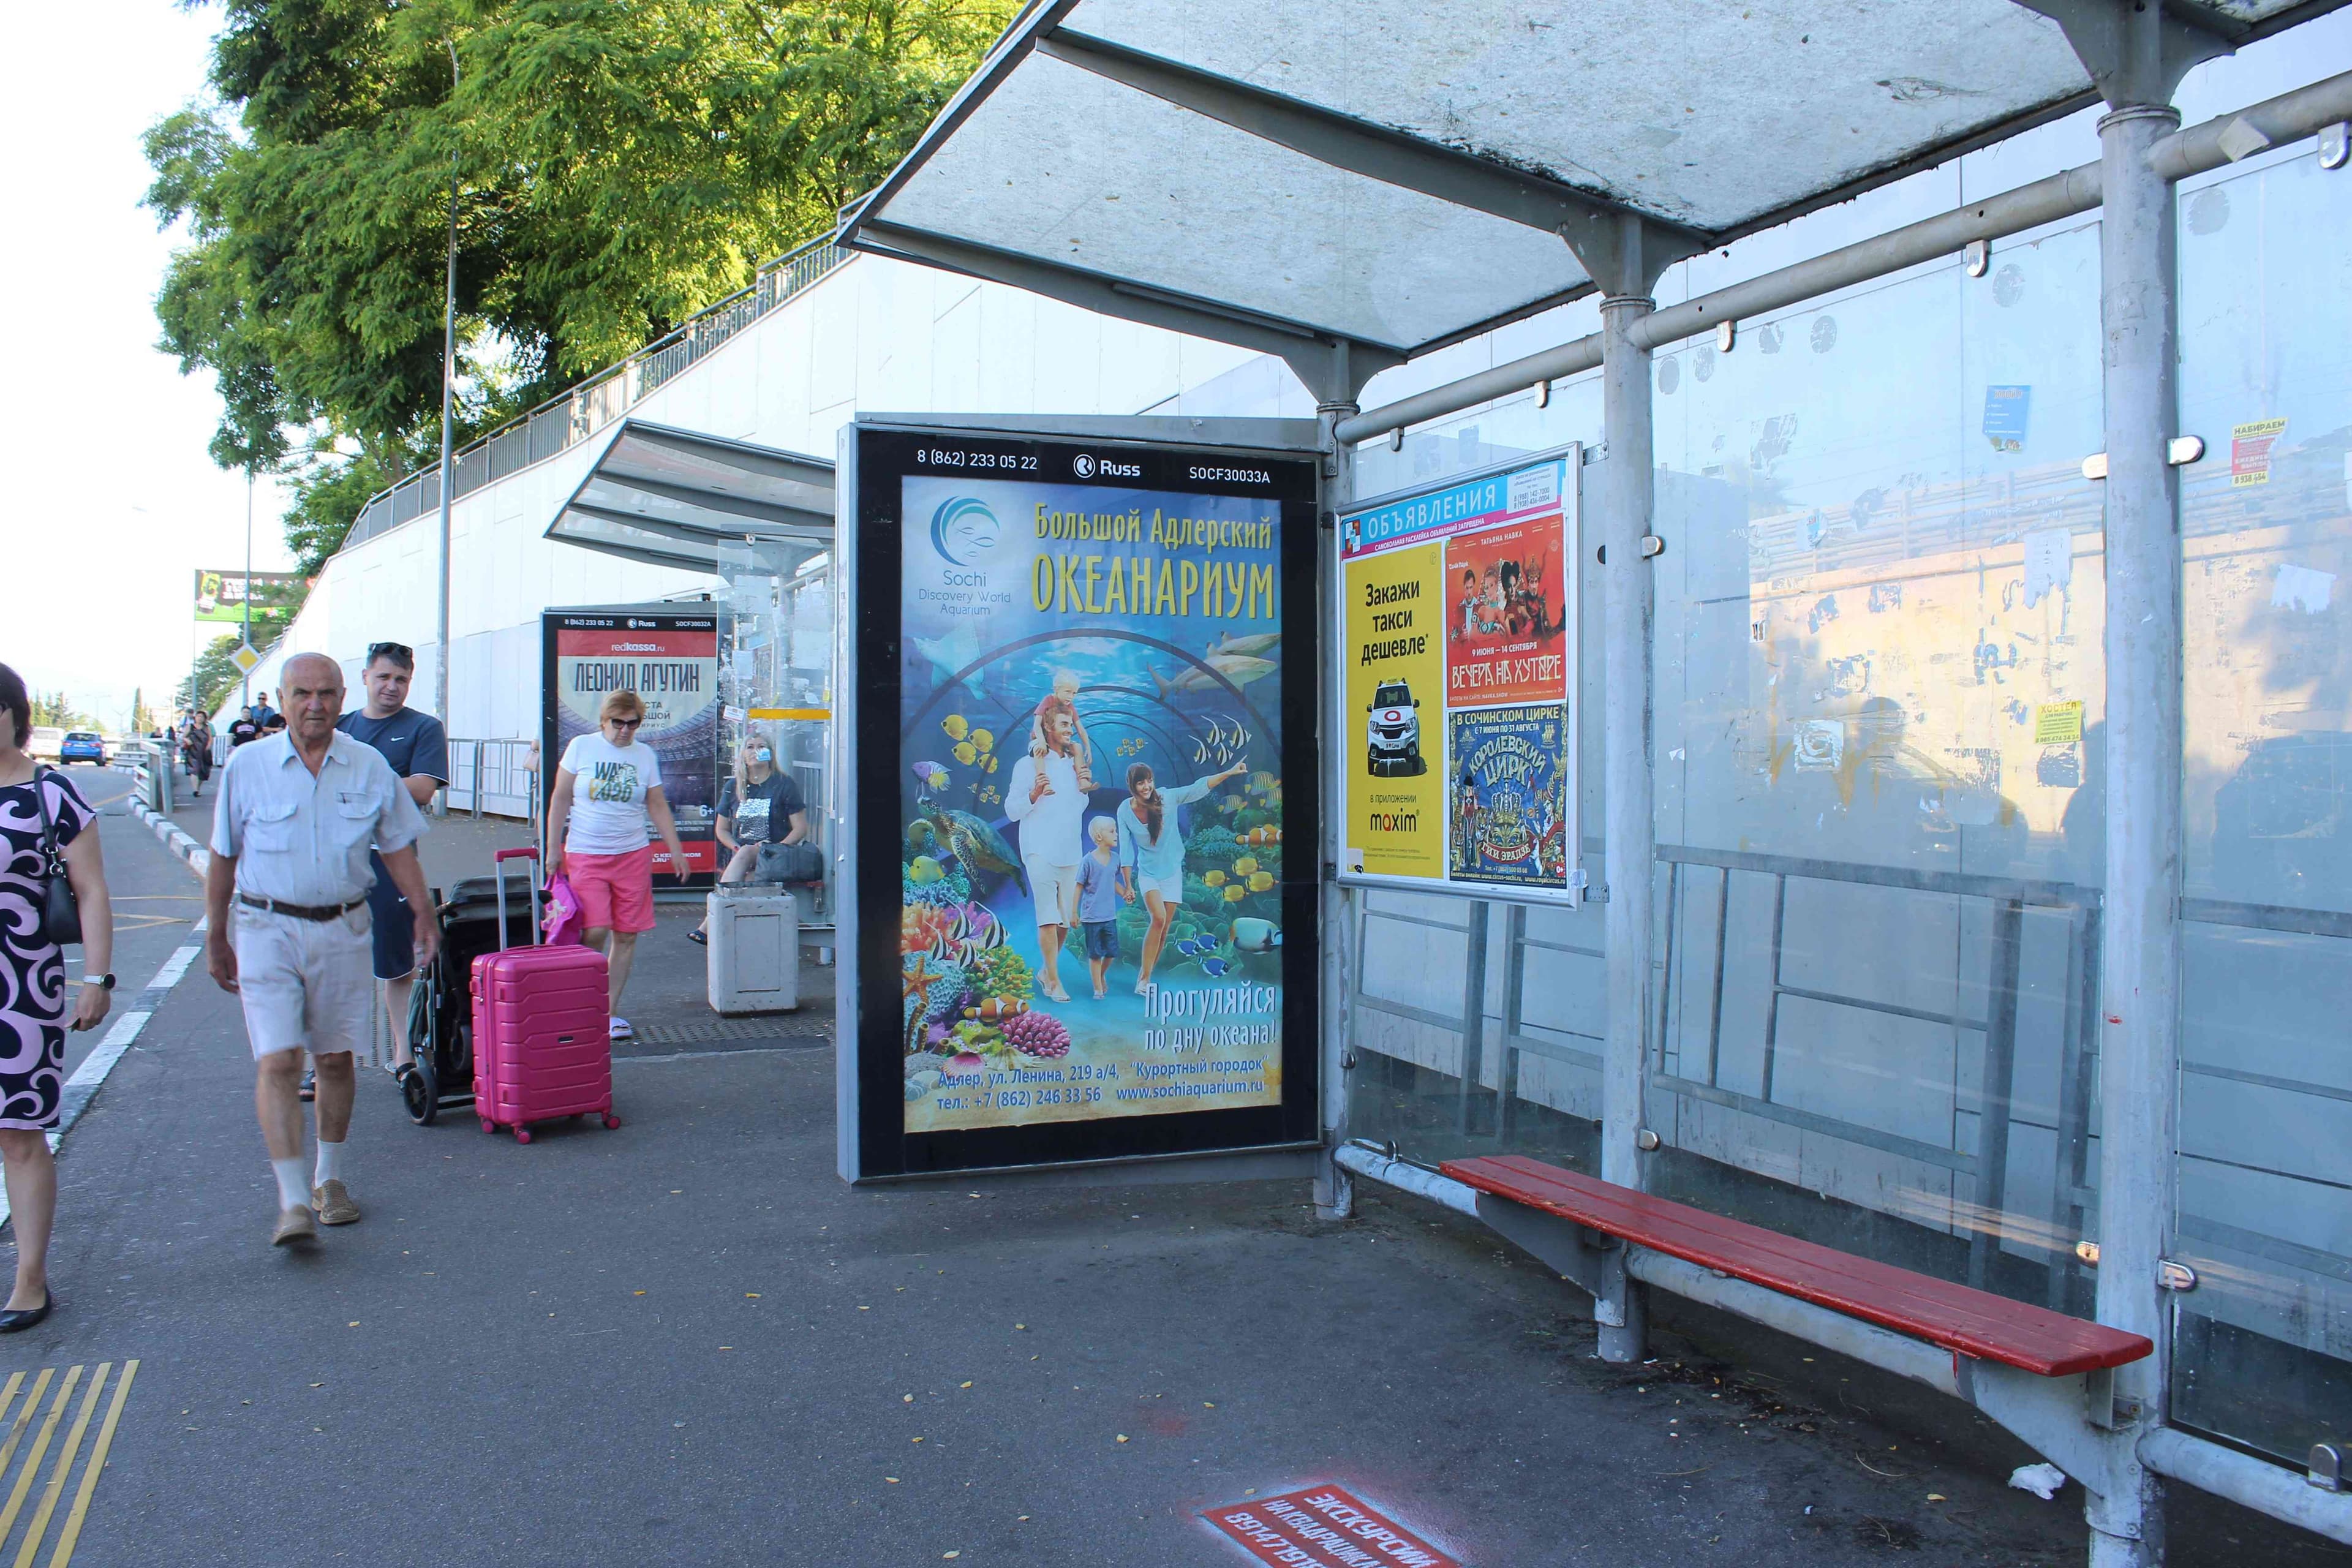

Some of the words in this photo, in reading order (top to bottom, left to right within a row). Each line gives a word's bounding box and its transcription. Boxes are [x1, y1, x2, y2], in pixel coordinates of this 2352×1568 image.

[2234, 420, 2285, 435] НАБИРАЕМ
[918, 450, 926, 463] 8
[931, 448, 965, 467] (862)
[970, 453, 995, 467] 233
[1000, 455, 1016, 469] 05
[1020, 456, 1038, 470] 22
[1100, 460, 1140, 477] Russ
[1189, 466, 1271, 483] SOCF30033A
[1368, 483, 1496, 539] ОБЪЯВЛЕНИЯ
[1034, 502, 1141, 543] Большой
[1150, 508, 1272, 554] Адлерский
[1374, 537, 1405, 552] САМОВОЛЬНАЯ
[1405, 532, 1430, 544] РАСКЛЕЙКА
[1430, 524, 1458, 538] ОБЪЯВЛЕНИЙ
[1458, 518, 1485, 531] ЗАПРЕЩЕНА
[1480, 535, 1503, 546] ТАТЬЯНА
[1504, 530, 1523, 541] НАВКА
[943, 570, 987, 587] Sochi
[1031, 553, 1275, 619] ОКЕАНАРИУМ
[919, 589, 973, 605] Discovery
[978, 591, 1011, 603] World
[1365, 580, 1420, 607] Закажи
[940, 603, 990, 617] Aquarium
[1372, 609, 1412, 633] такси
[611, 642, 665, 652] redkassa.ru
[1471, 649, 1476, 657] 9
[1477, 646, 1494, 657] ИЮНЯ
[1501, 644, 1508, 654] 14
[1509, 641, 1537, 653] СЕНТЯБРЯ
[575, 663, 637, 692] ЛЕОНИД
[641, 663, 700, 692] АГУТИН
[1452, 662, 1494, 689] ВЕЧЕРА
[1496, 660, 1512, 685] НА
[1514, 654, 1562, 684] ХУТОРЕ
[1457, 714, 1463, 726] В
[1464, 709, 1524, 725] СОЧИНСКОМ
[1526, 706, 1559, 723] ЦИРКЕ
[2041, 701, 2076, 714] ХОСТЕЛ
[1483, 725, 1499, 734] ИЮНЯ
[1500, 725, 1508, 733] ПО
[1515, 723, 1540, 732] АВГУСТА
[1468, 734, 1547, 777] КОРОЛЕВСКИЙ
[1482, 754, 1531, 788] ЦИРК
[699, 804, 714, 817] 6+
[1374, 794, 1417, 805] приложении
[1370, 807, 1417, 832] maxim
[1501, 843, 1531, 861] ЭРАДЗЕ
[1144, 979, 1277, 1025] Прогуляйся
[1144, 1028, 1166, 1050] по
[1172, 1027, 1205, 1054] дну
[1210, 1019, 1276, 1047] океана!
[938, 1072, 986, 1090] Адлер,
[988, 1072, 1008, 1089] ул.
[1011, 1068, 1067, 1084] Ленина,
[1070, 1065, 1093, 1081] 219
[1096, 1063, 1121, 1082] а/4,
[937, 1097, 969, 1110] тел.:
[974, 1091, 993, 1108] +7
[996, 1090, 1033, 1109] (862)
[1036, 1088, 1062, 1104] 246
[1065, 1087, 1082, 1103] 33
[1085, 1087, 1102, 1102] 56
[1116, 1078, 1265, 1101] www.sochiaquarium.ru
[1260, 1499, 1296, 1515] НА
[1278, 1510, 1388, 1568] КВАДРАЦИКЛ
[1303, 1493, 1439, 1568] ЭКСКУРСИИ
